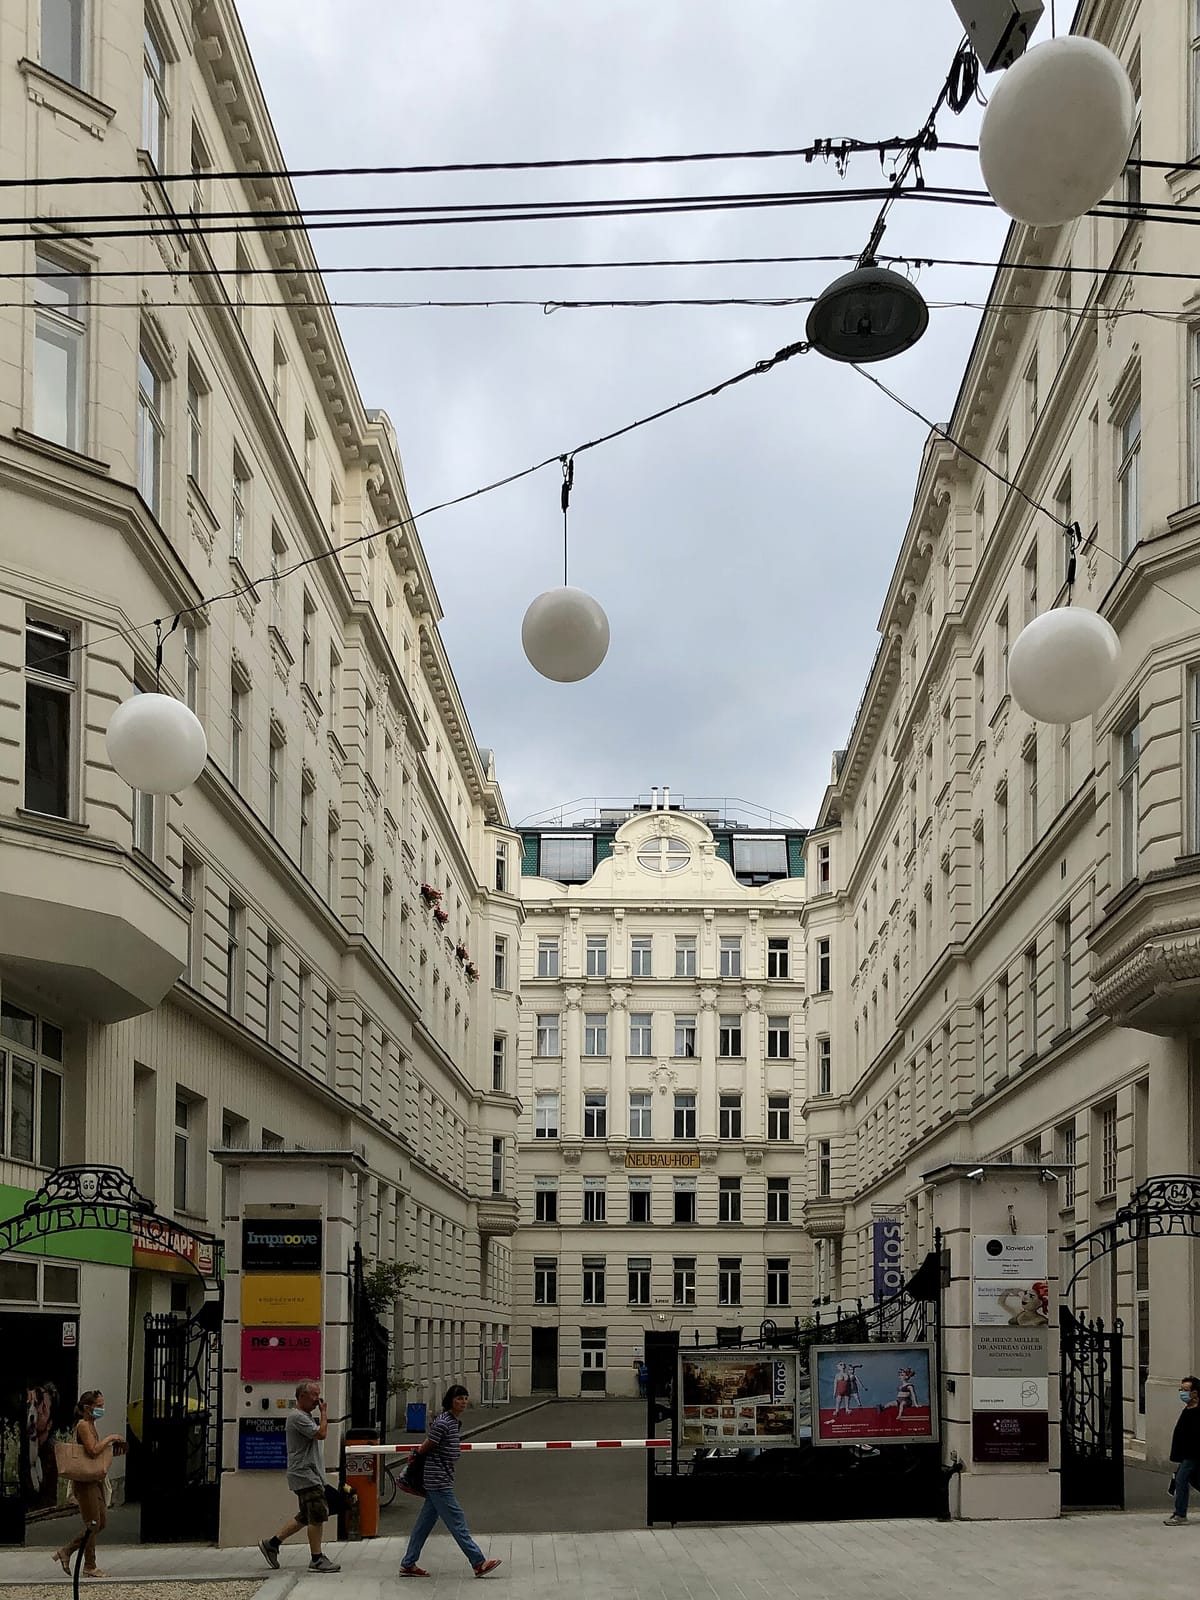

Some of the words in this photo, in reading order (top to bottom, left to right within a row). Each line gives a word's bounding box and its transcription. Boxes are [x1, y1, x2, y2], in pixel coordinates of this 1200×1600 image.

[628, 1154, 697, 1166] NEUBAU-HOF
[1171, 1183, 1188, 1198] 64
[246, 1231, 318, 1248] Improove
[288, 1337, 311, 1347] LAB
